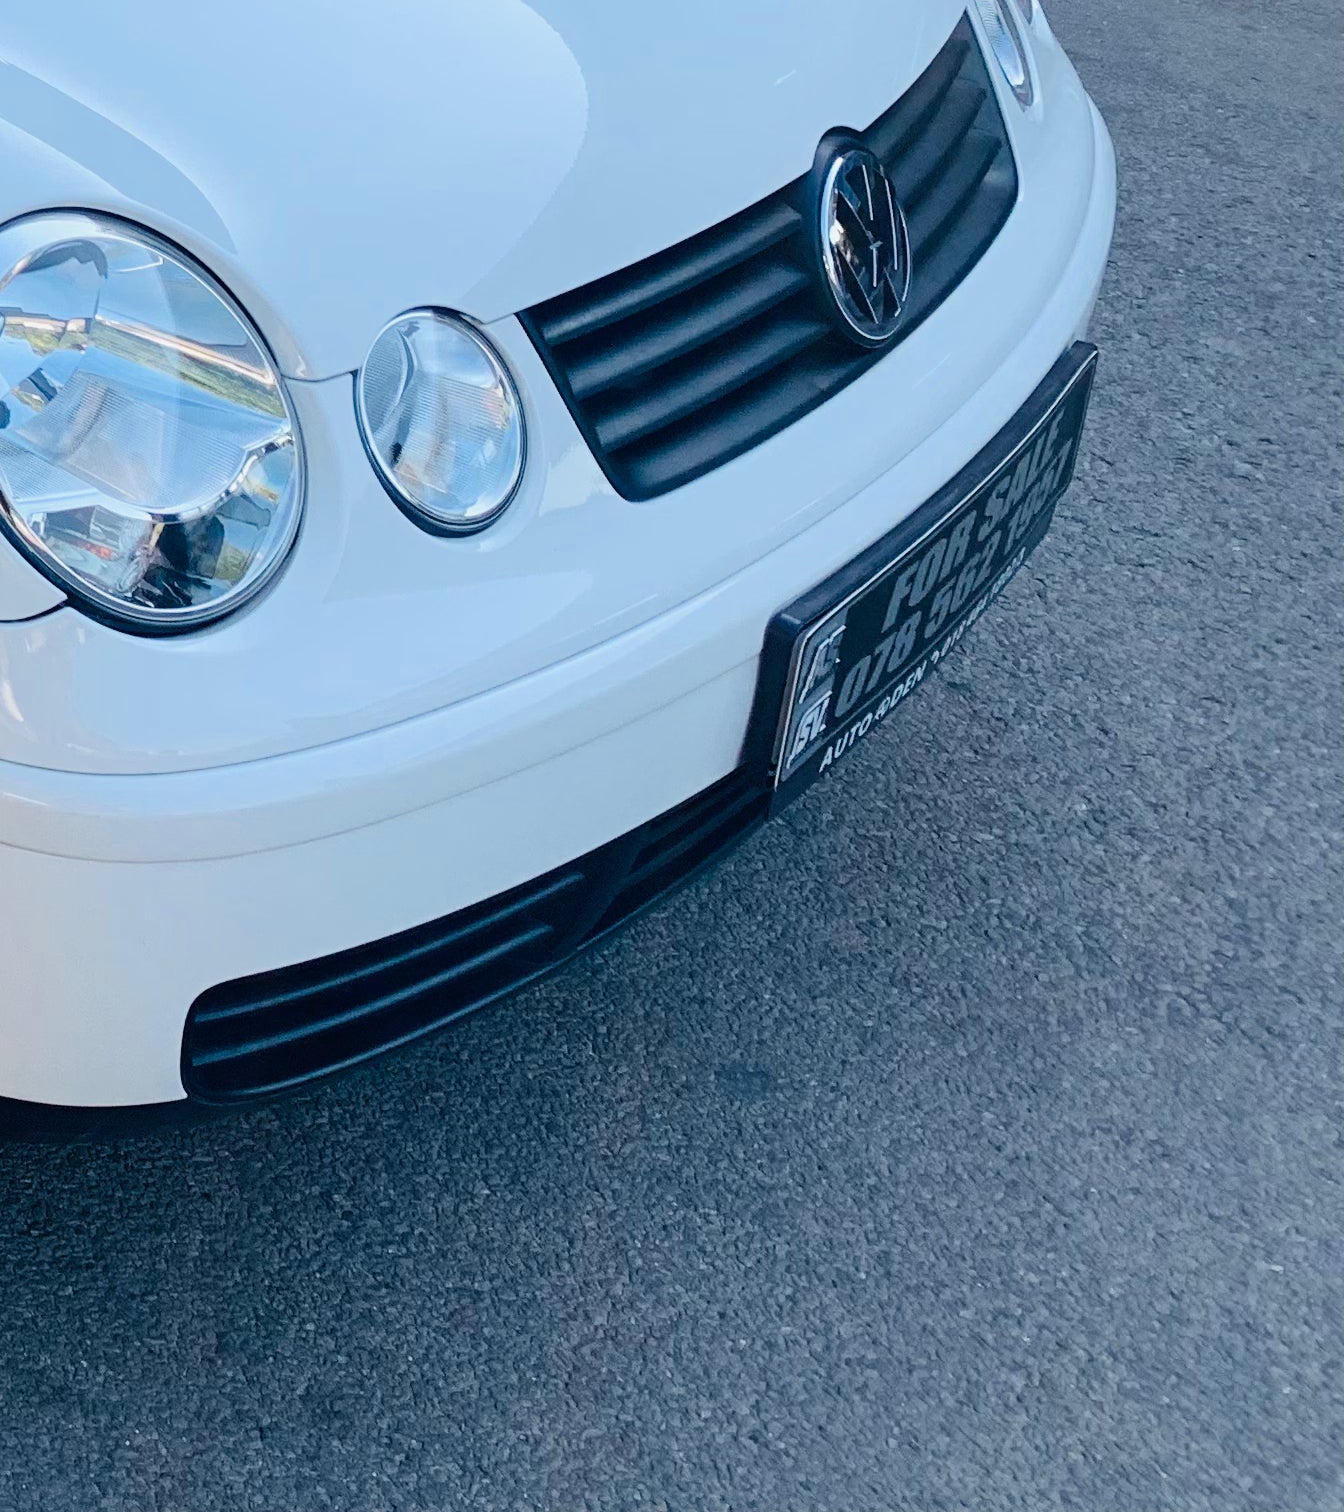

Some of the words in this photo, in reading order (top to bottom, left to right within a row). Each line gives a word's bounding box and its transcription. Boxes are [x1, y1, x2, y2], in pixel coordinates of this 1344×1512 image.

[880, 509, 978, 634] FOR
[977, 407, 1066, 542] SALE
[834, 611, 923, 718] 078
[924, 529, 1003, 639] 562
[818, 713, 874, 774] AUTO
